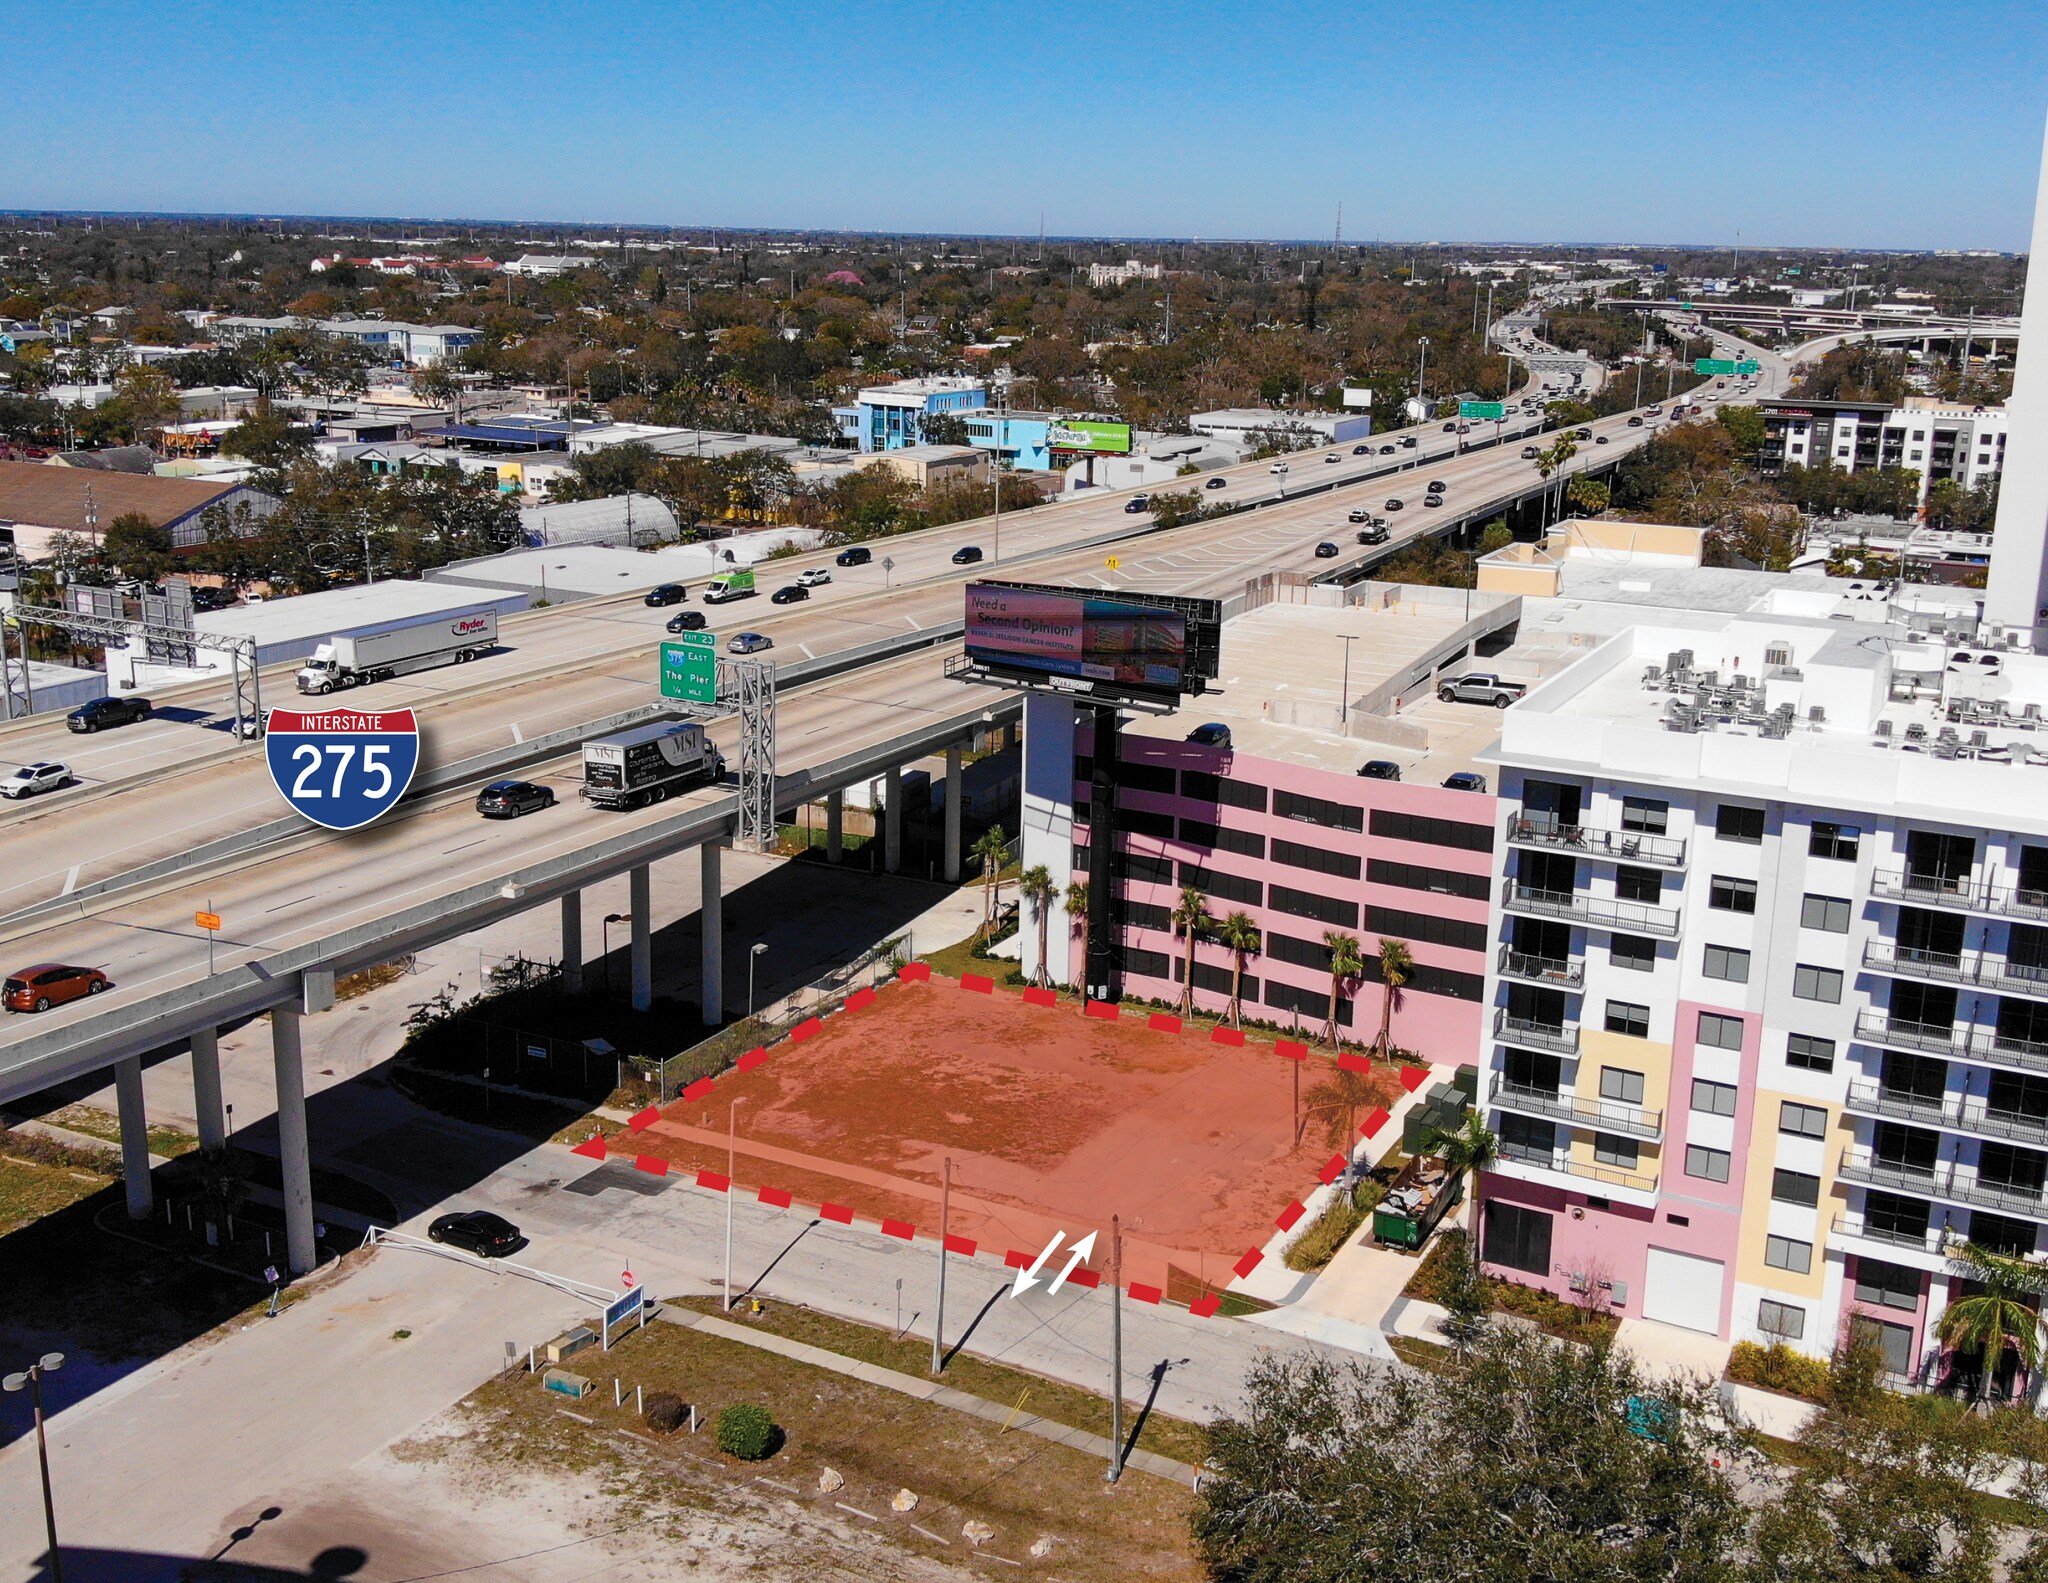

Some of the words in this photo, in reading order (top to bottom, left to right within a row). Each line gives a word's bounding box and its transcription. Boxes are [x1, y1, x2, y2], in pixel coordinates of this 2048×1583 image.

[971, 596, 999, 611] Need
[1000, 602, 1007, 612] a
[459, 619, 485, 632] Ryder
[977, 612, 1019, 629] Second
[1022, 618, 1075, 638] Opinion?
[702, 635, 713, 645] 23
[669, 653, 683, 662] 375
[688, 652, 708, 662] EAST
[665, 670, 683, 681] The
[690, 673, 710, 685] Pier
[688, 688, 702, 697] MILE
